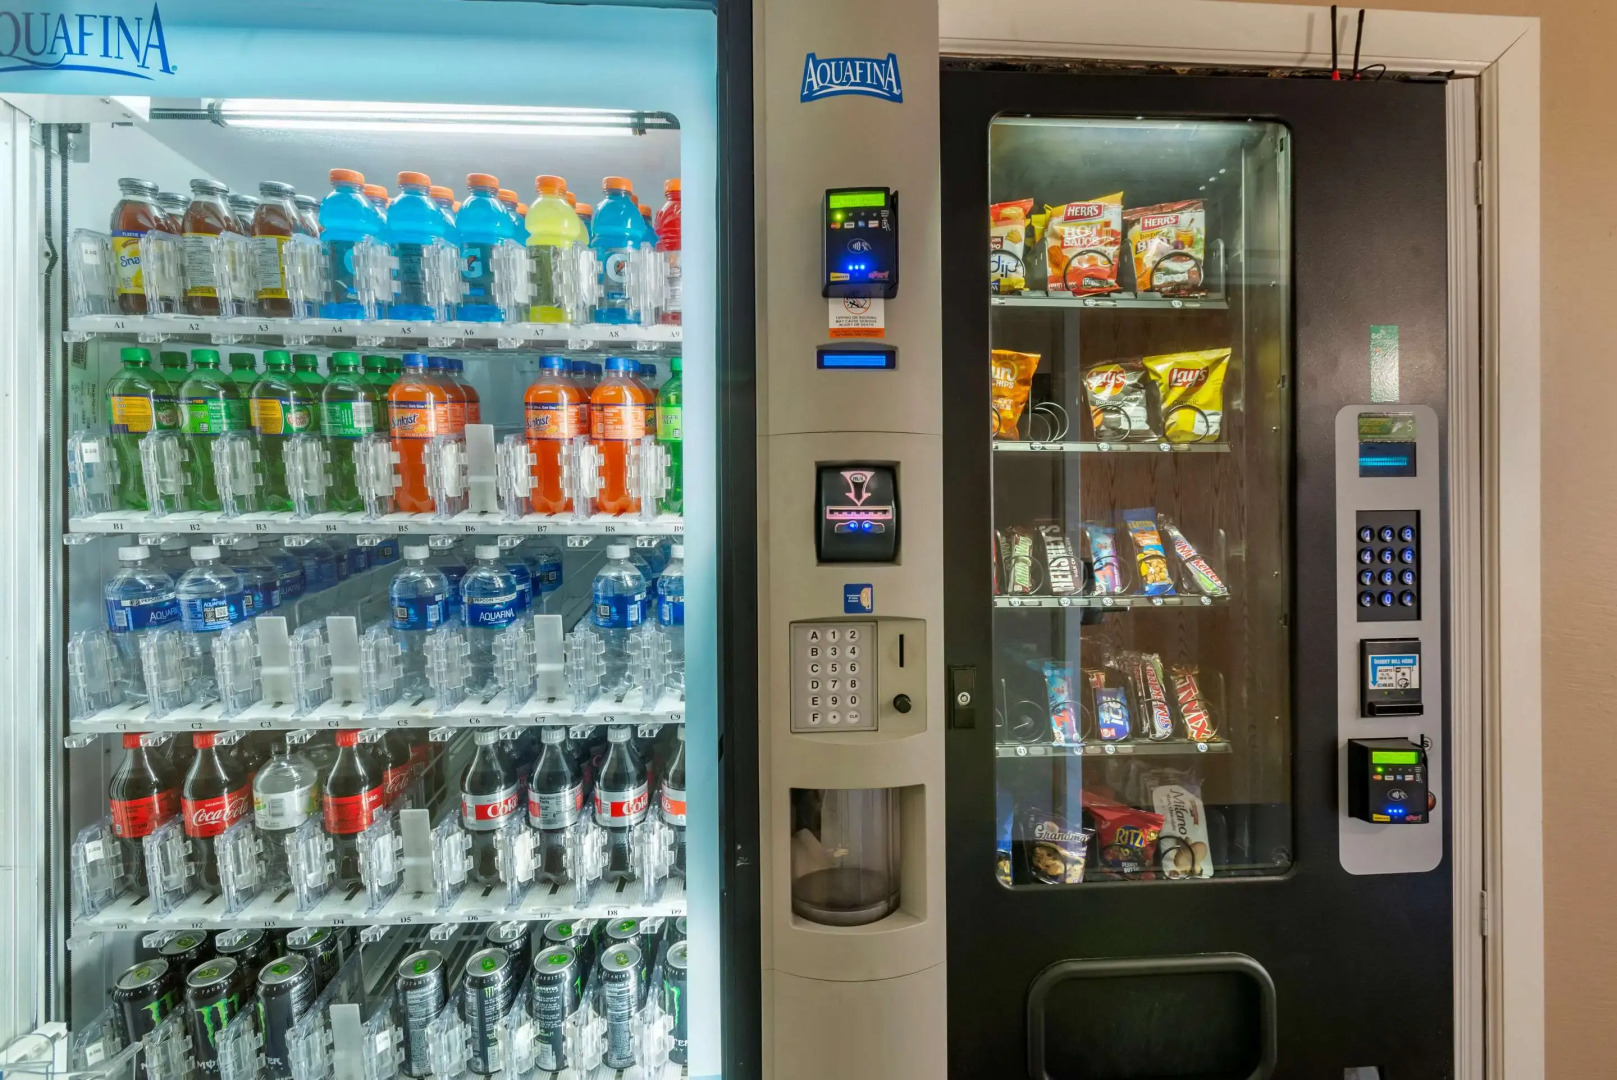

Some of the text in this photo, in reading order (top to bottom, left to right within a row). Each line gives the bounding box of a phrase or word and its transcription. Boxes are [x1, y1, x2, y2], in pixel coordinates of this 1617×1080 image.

[803, 57, 901, 94] AQUAFINA
[1067, 204, 1099, 217] HERR'S
[1144, 217, 1177, 226] HERR'S
[1063, 225, 1101, 238] HOT
[258, 324, 268, 332] A3
[1171, 368, 1207, 388] Lay's
[992, 380, 1014, 388] HIPS
[1365, 530, 1411, 539] 1 2 3
[1039, 525, 1074, 592] HERSHEY'S
[1364, 551, 1412, 561] 4 5 6
[1366, 573, 1412, 582] 7 8 9
[1386, 594, 1391, 604] 0
[479, 608, 515, 622] AQUAFINA
[811, 631, 856, 640] A 1 2
[811, 648, 818, 656] B
[850, 647, 856, 655] 4
[811, 664, 819, 673] C
[831, 664, 837, 672] 5
[811, 680, 856, 689] D 7 8
[812, 696, 856, 705] E 9 0
[813, 714, 818, 722] F
[328, 720, 338, 728] C4
[487, 794, 518, 818] Coke
[1115, 828, 1145, 848] RITZ
